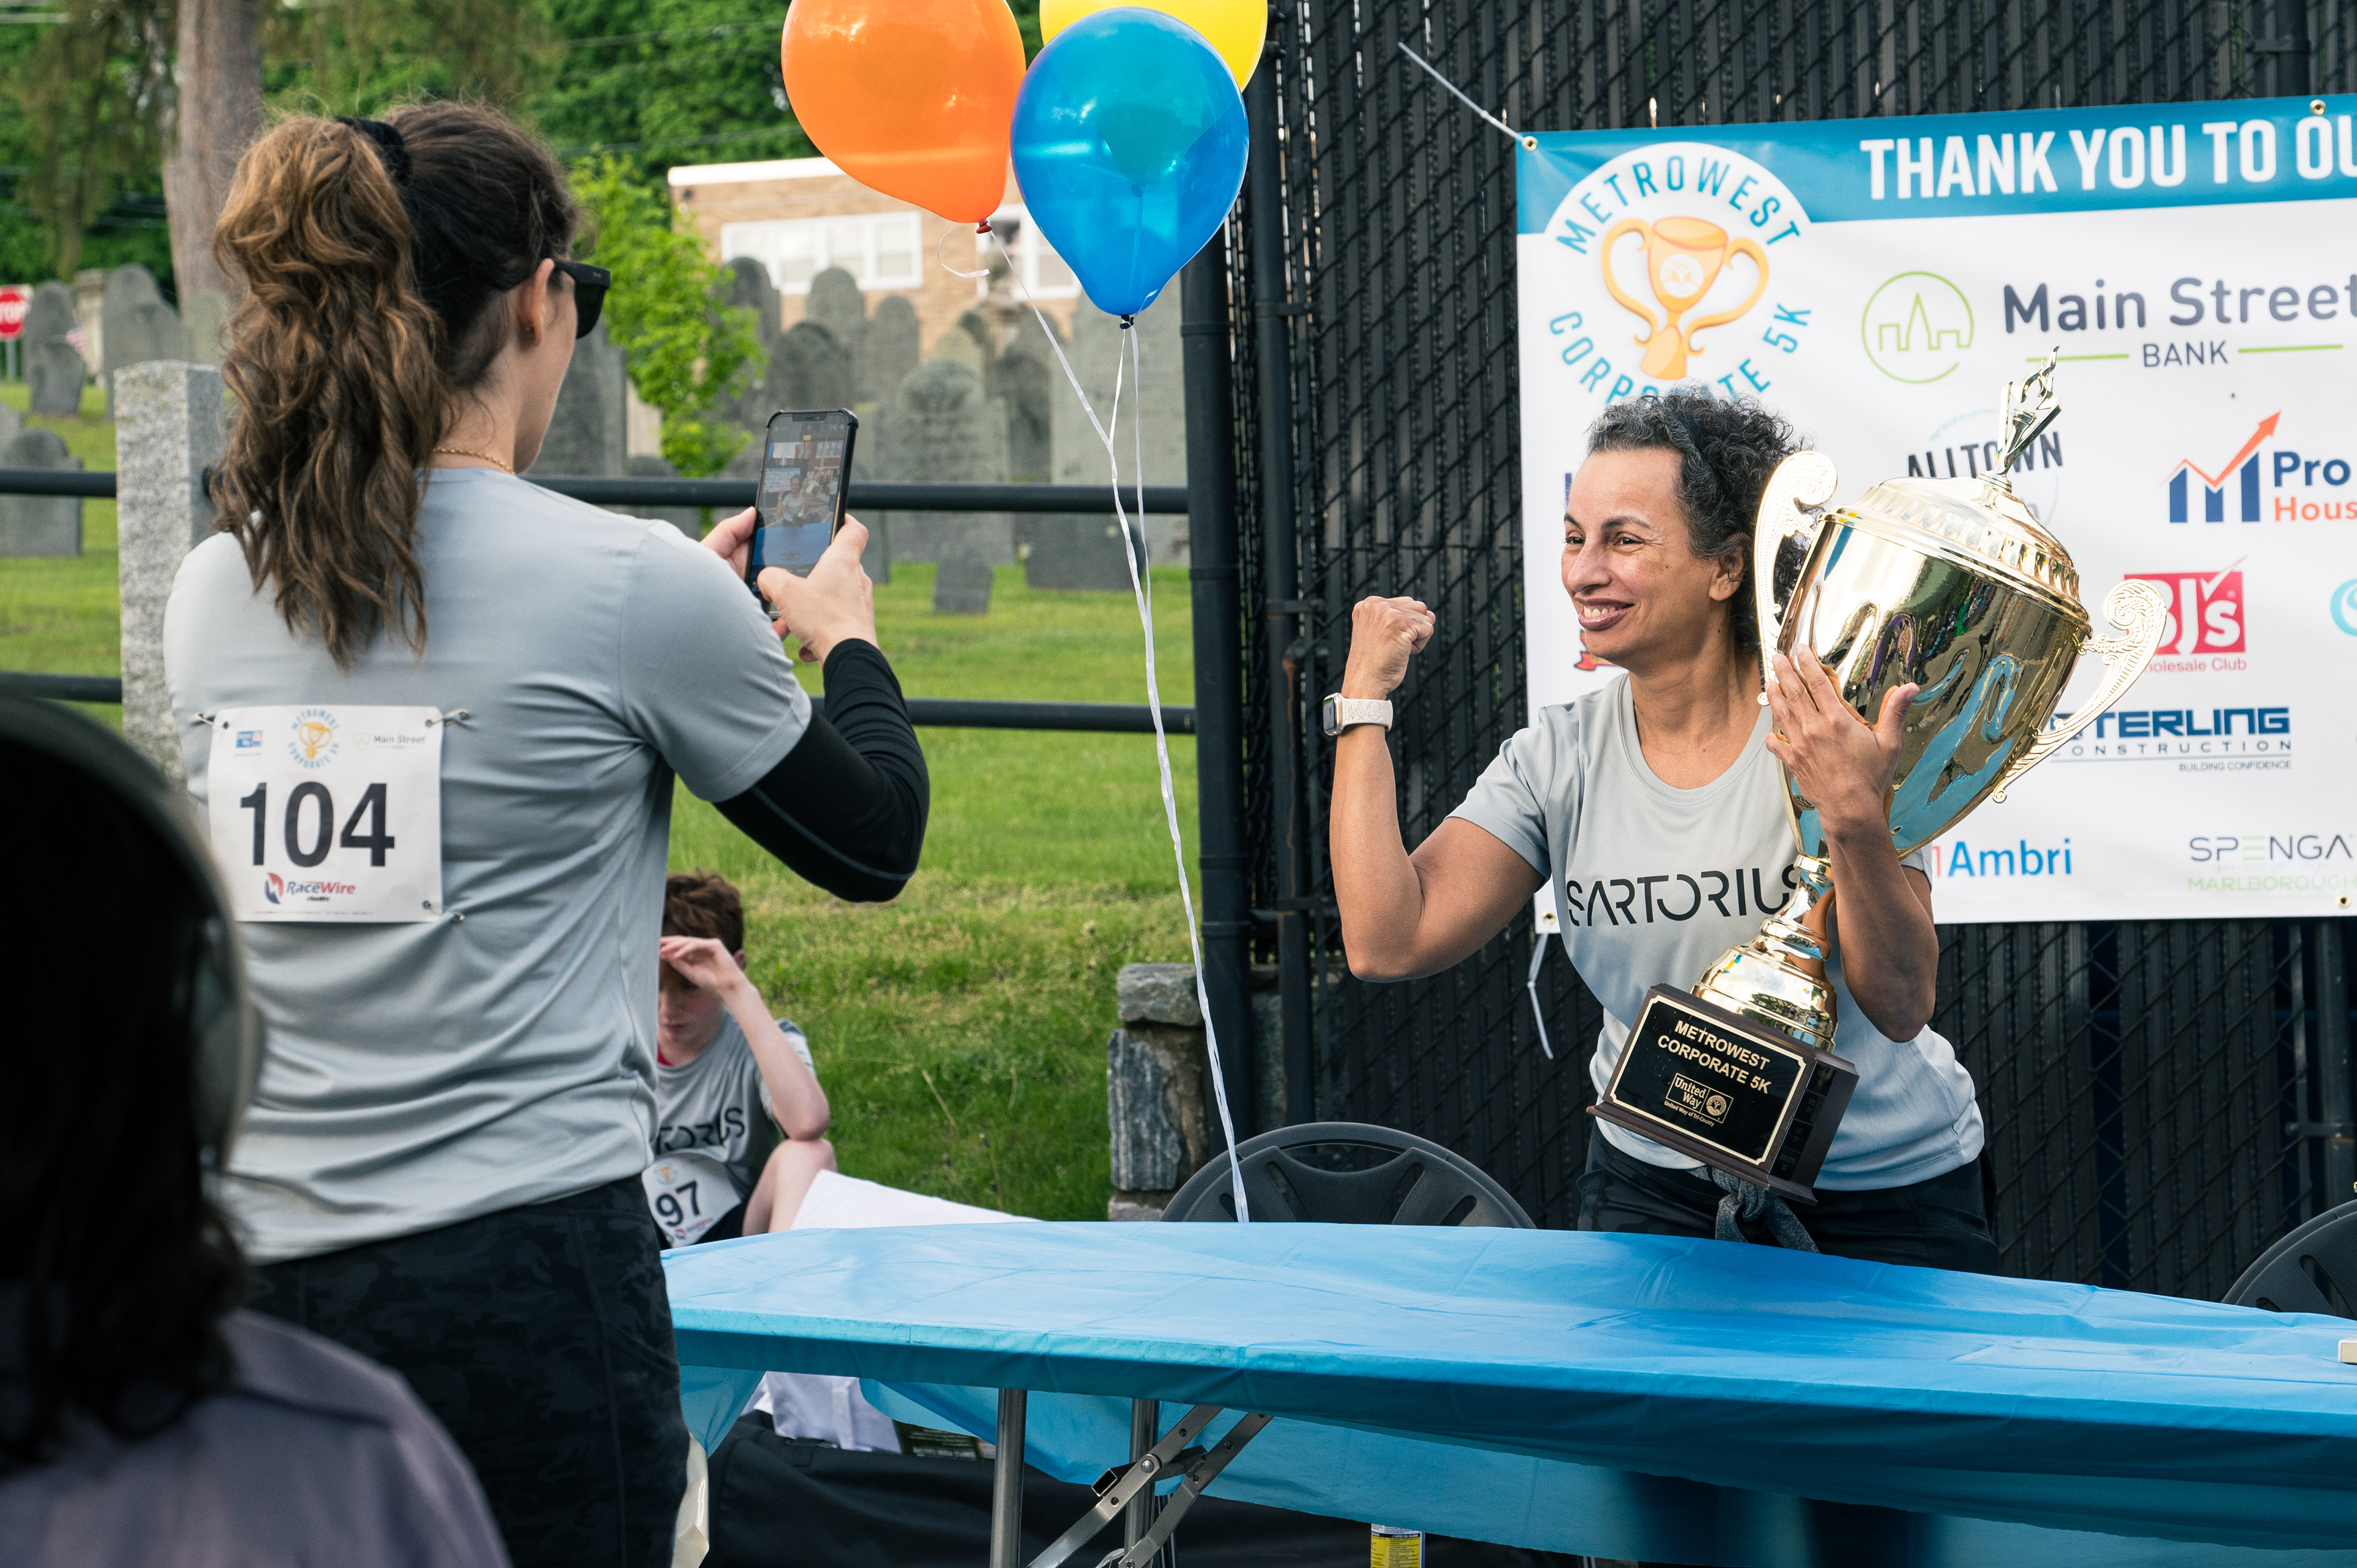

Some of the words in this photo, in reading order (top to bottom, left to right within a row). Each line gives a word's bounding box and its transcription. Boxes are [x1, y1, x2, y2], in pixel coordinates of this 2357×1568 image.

[1859, 131, 2058, 200] THANK
[2069, 125, 2187, 190] YOU
[2202, 120, 2277, 184] TO
[1557, 155, 1802, 255] METROWEST
[2003, 279, 2146, 334] Main
[2169, 274, 2357, 327] Street
[1762, 303, 1812, 354] 5K
[2142, 340, 2229, 368] BANK
[2273, 450, 2351, 487] Pro
[2211, 657, 2247, 671] Club
[2179, 762, 2225, 772] BUILDING
[2227, 760, 2292, 771] CONFIDENCE
[240, 781, 395, 868] 104
[1948, 837, 2072, 878] Ambri
[2189, 834, 2353, 861] SPENGA
[286, 881, 356, 895] RaceWire
[2188, 875, 2357, 892] MARLBOROUGH
[1674, 1020, 1770, 1070] METROWEST
[1658, 1035, 1749, 1084] CORPORATE
[1750, 1075, 1772, 1094] 5K
[1674, 1076, 1706, 1099] United
[1682, 1091, 1703, 1110] Way
[1664, 1100, 1679, 1111] United
[1679, 1106, 1688, 1116] Way
[1693, 1112, 1715, 1127] Tri-County
[656, 1180, 700, 1227] 97
